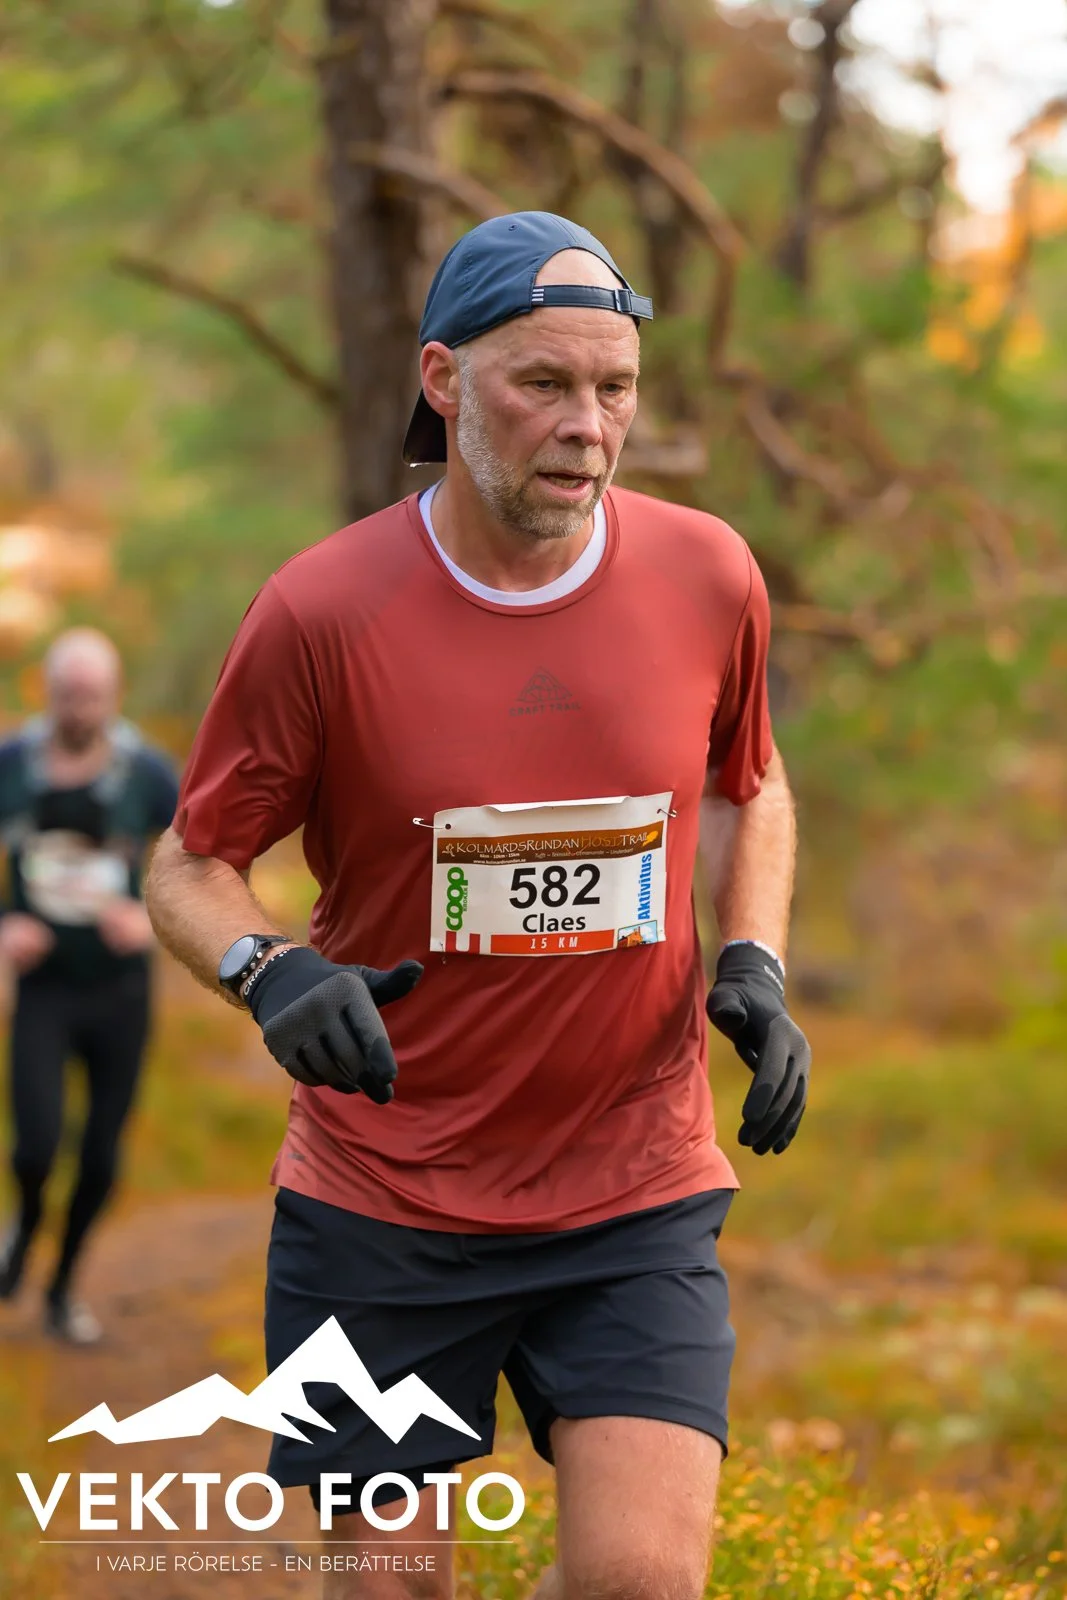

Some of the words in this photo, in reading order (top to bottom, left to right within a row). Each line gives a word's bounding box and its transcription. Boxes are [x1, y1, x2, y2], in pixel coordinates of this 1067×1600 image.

[509, 704, 545, 717] CRAFT
[446, 867, 468, 931] coop
[509, 863, 600, 909] 582
[638, 853, 652, 920] Aktivitus
[522, 913, 586, 933] Claes
[558, 936, 578, 948] KM
